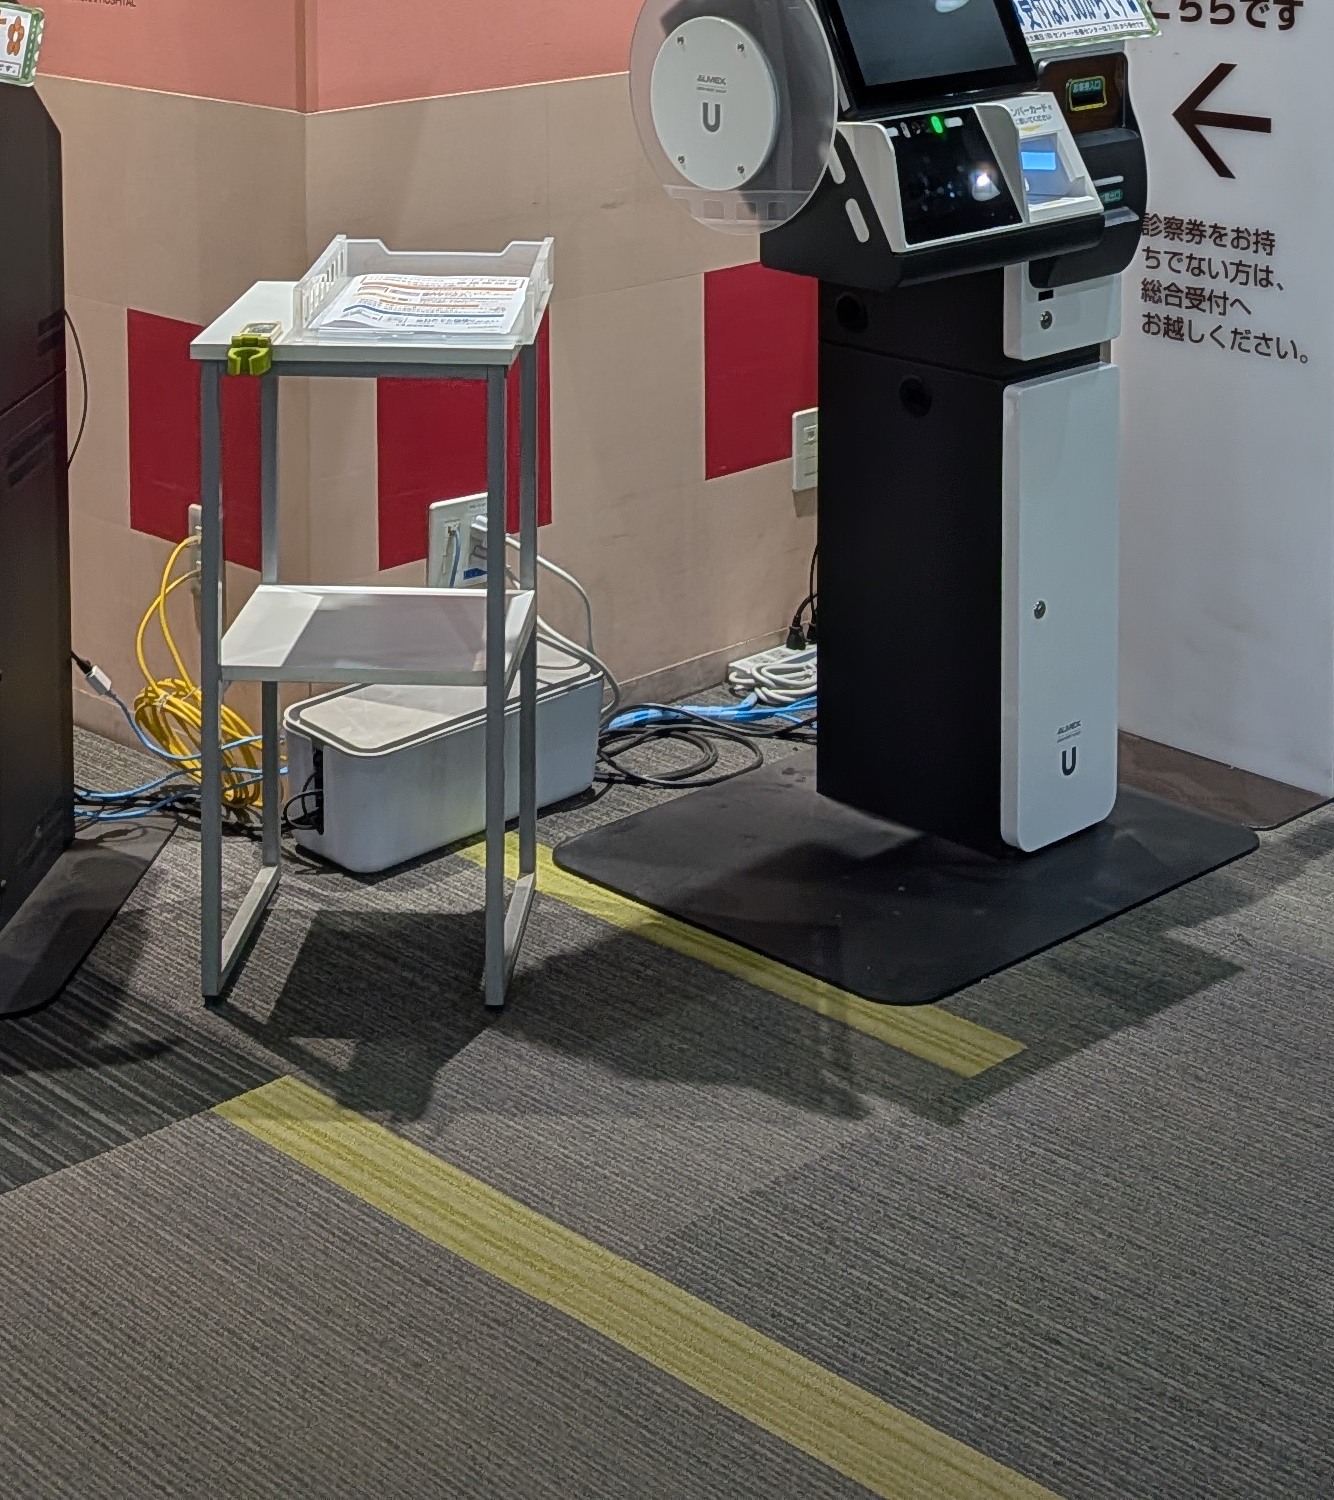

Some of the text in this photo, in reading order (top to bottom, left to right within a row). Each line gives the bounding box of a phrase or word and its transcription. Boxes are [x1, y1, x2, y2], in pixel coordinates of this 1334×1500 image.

[1010, 103, 1053, 117] ンバーカードを
[1141, 213, 1276, 257] 診察券をお持
[1142, 246, 1285, 291] ちでない方は、
[1140, 277, 1252, 317] 総合受付へ
[1142, 311, 1309, 365] お越しください。
